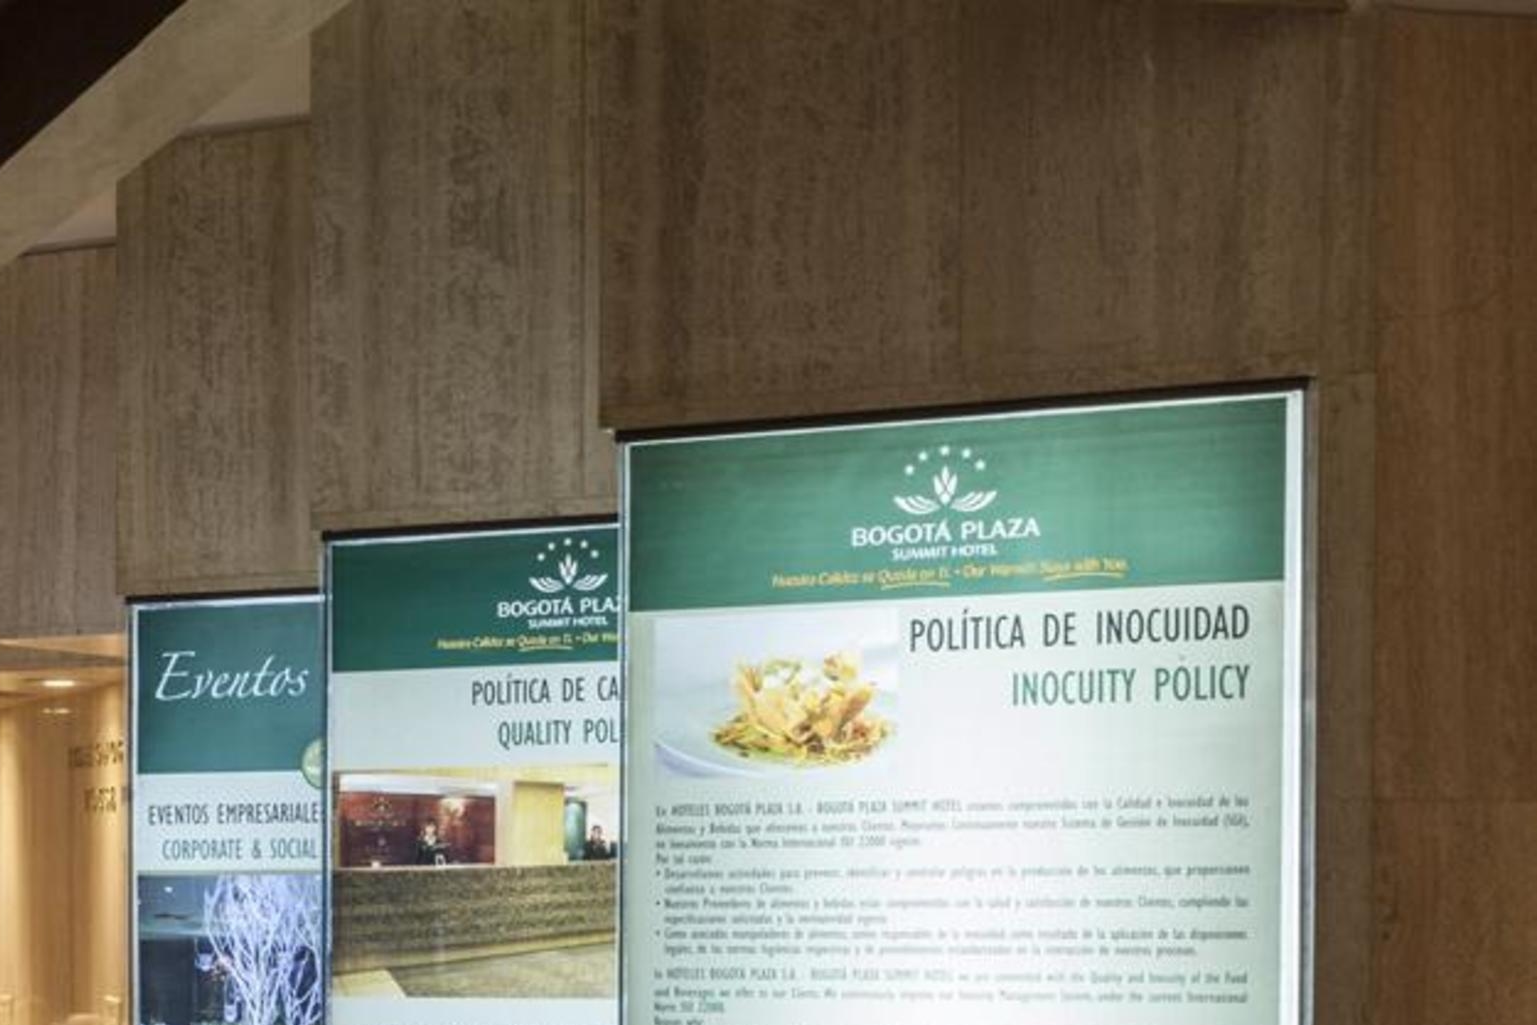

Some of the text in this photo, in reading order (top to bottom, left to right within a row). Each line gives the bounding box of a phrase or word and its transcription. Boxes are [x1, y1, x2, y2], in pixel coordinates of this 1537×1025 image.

[851, 518, 1041, 548] BOGOTÁ PLAZA
[892, 543, 998, 562] SUMMIT HOTEL
[498, 596, 573, 618] BOGOTÁ
[528, 616, 608, 629] SUMMIT HOTEL
[909, 603, 1250, 653] POLÍTICA DE INOCUIDAD
[154, 650, 311, 701] Eventos
[472, 673, 550, 706] POLÍTICA
[563, 677, 585, 701] DE
[1012, 664, 1250, 707] INOCUITY POLICY
[498, 720, 572, 750] QUALITY
[148, 801, 324, 826] EVENTOS EMPRESARIALE
[162, 839, 242, 860] CORPORATE
[251, 839, 263, 858] &
